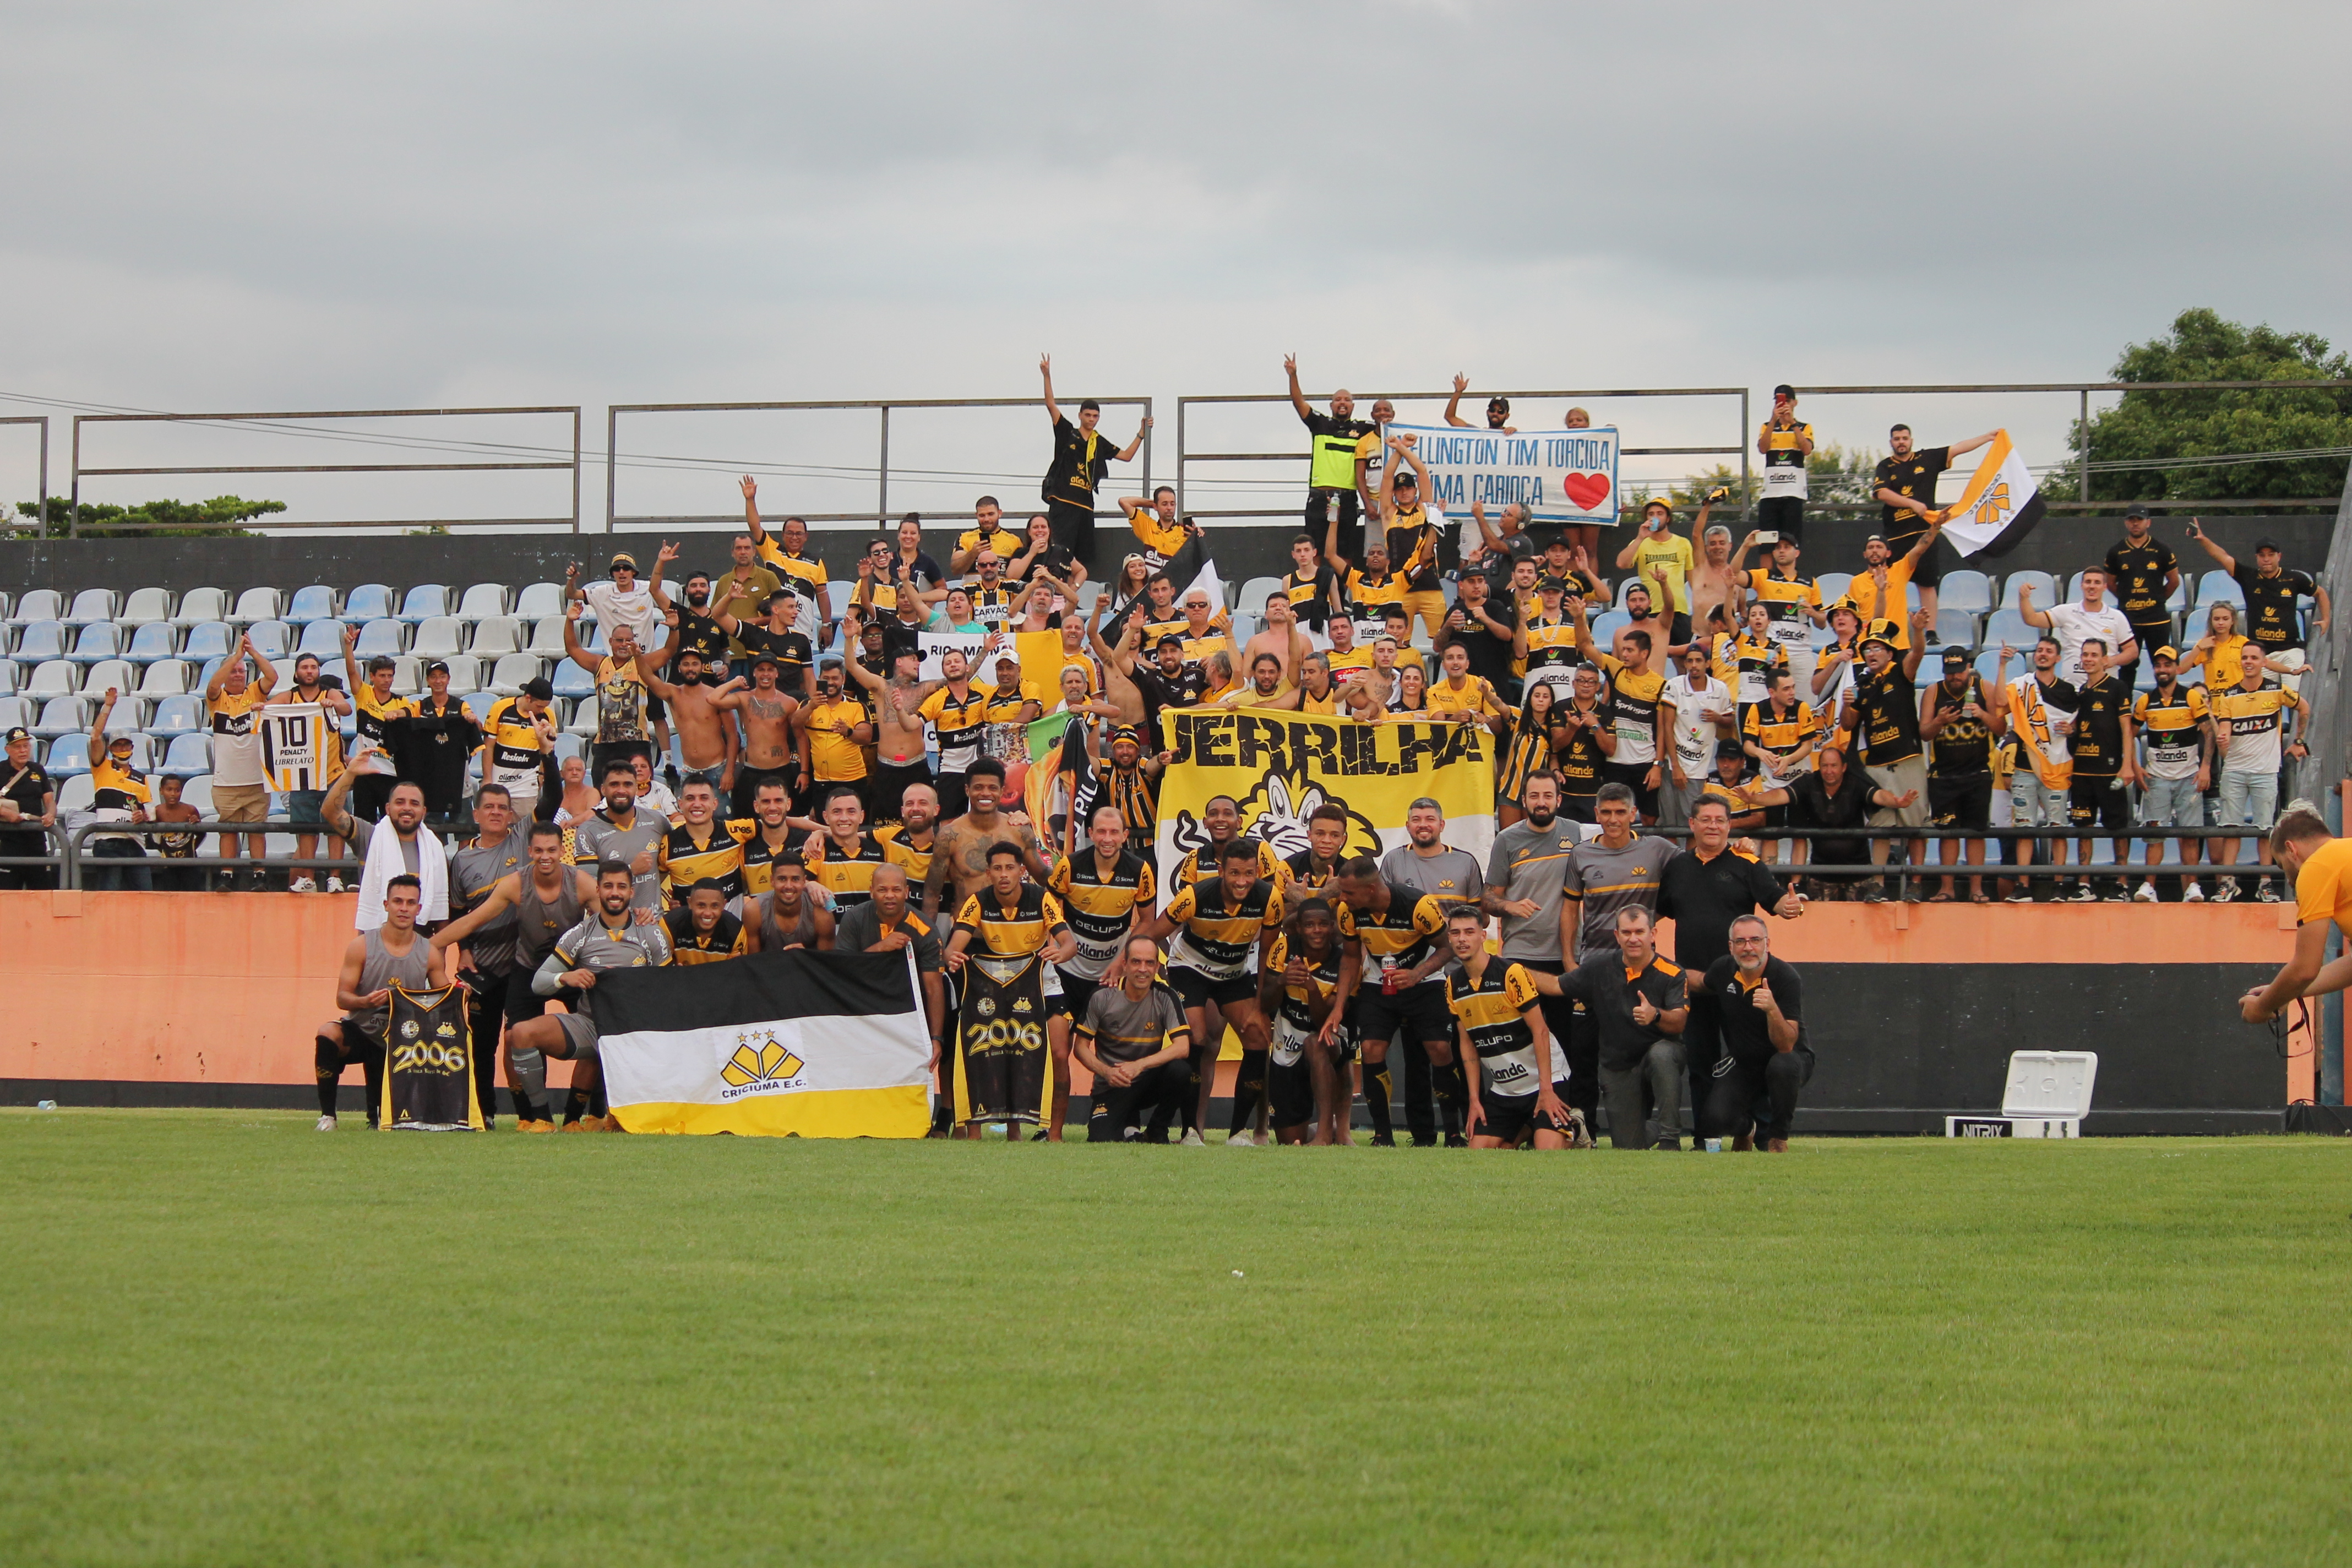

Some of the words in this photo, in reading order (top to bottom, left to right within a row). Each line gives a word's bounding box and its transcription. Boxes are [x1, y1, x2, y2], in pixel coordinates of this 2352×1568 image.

[1393, 435, 1498, 465] LLINGTON
[1505, 439, 1539, 466] TIM
[1545, 439, 1609, 470] TORCIDA
[1473, 475, 1542, 505] CARIOCA
[974, 605, 1008, 616] CARVÃO
[2255, 627, 2286, 639] alianda
[930, 645, 951, 656] RIO
[1184, 673, 1196, 682] SAINT
[1615, 699, 1652, 715] Springer
[277, 716, 307, 748] 10
[2232, 718, 2272, 732] CAIXA
[275, 757, 314, 766] LIBRELATO
[1564, 764, 1594, 775] alianda
[967, 1017, 1042, 1056] 2006
[392, 1039, 466, 1074] 2006
[722, 1081, 780, 1098] CRICIÚMA
[783, 1079, 807, 1089] E.C.
[1963, 1124, 2003, 1138] NITRIX
